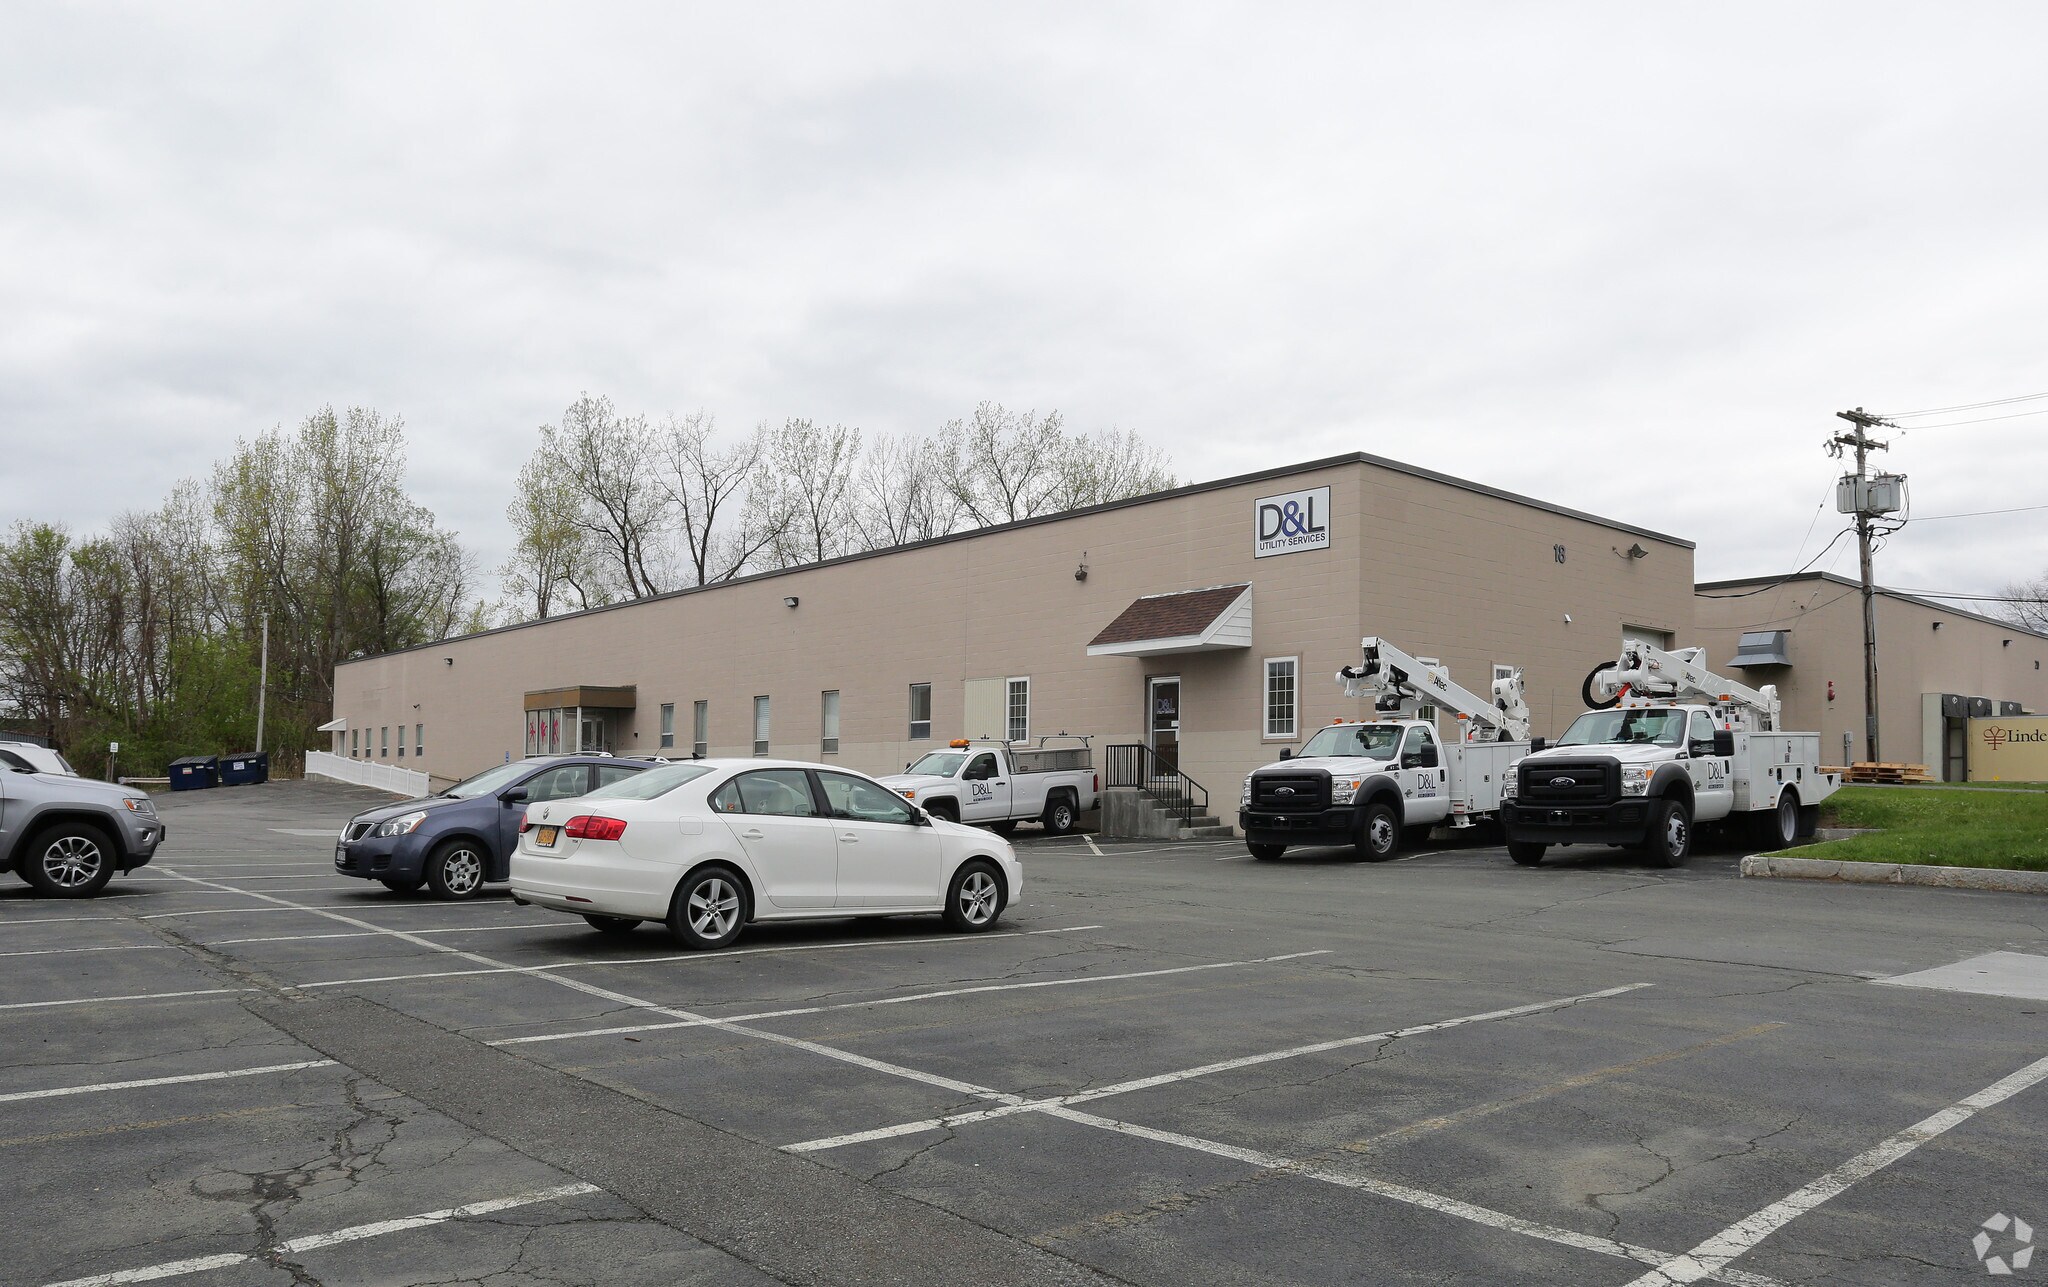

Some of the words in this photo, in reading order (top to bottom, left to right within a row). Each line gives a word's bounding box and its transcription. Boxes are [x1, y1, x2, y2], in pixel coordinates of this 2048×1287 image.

[1260, 496, 1325, 541] D&L
[1260, 539, 1287, 551] UTILITY
[1288, 532, 1326, 546] SERVICES
[1553, 544, 1566, 564] 18
[1433, 675, 1448, 692] Altec
[1707, 761, 1725, 780] D&L
[972, 782, 993, 796] D&L
[1417, 773, 1436, 790] D&L
